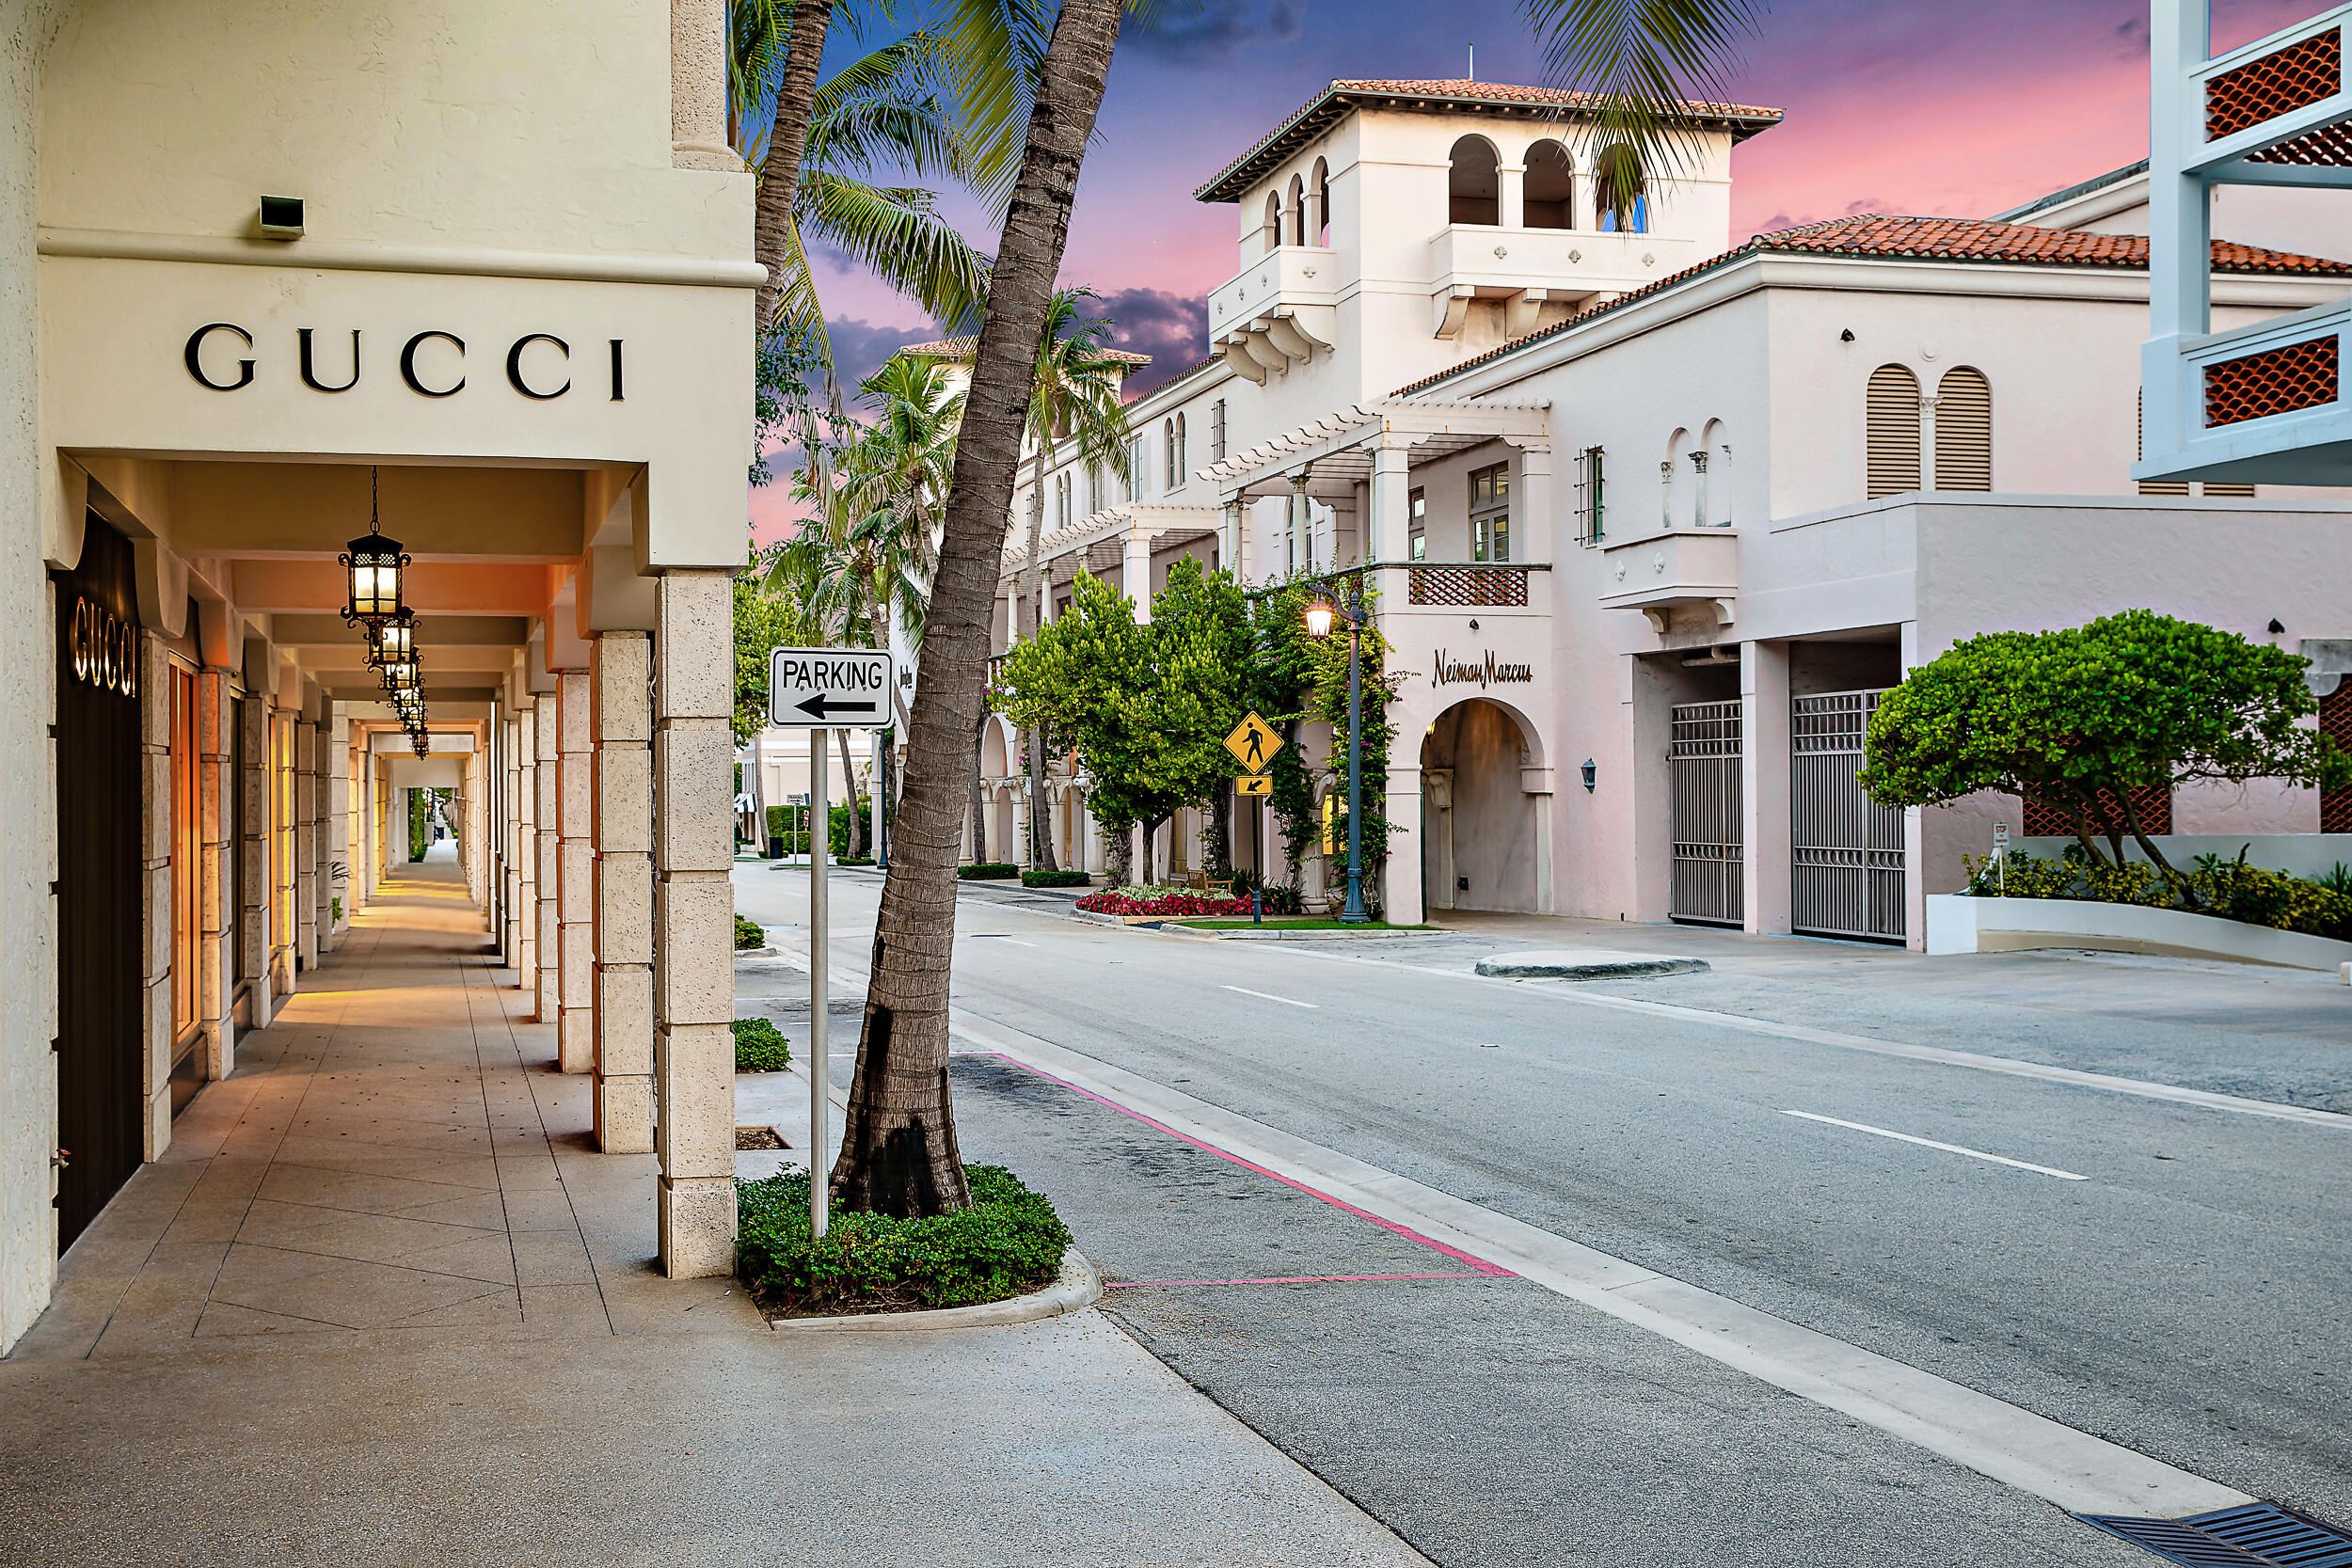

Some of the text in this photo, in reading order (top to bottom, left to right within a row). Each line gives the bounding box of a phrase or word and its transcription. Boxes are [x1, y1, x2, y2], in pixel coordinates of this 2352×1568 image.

[183, 322, 626, 402] GUCCI
[74, 595, 136, 698] GUCCI
[783, 659, 882, 690] PARKING
[1431, 647, 1534, 690] Neiman Marcus
